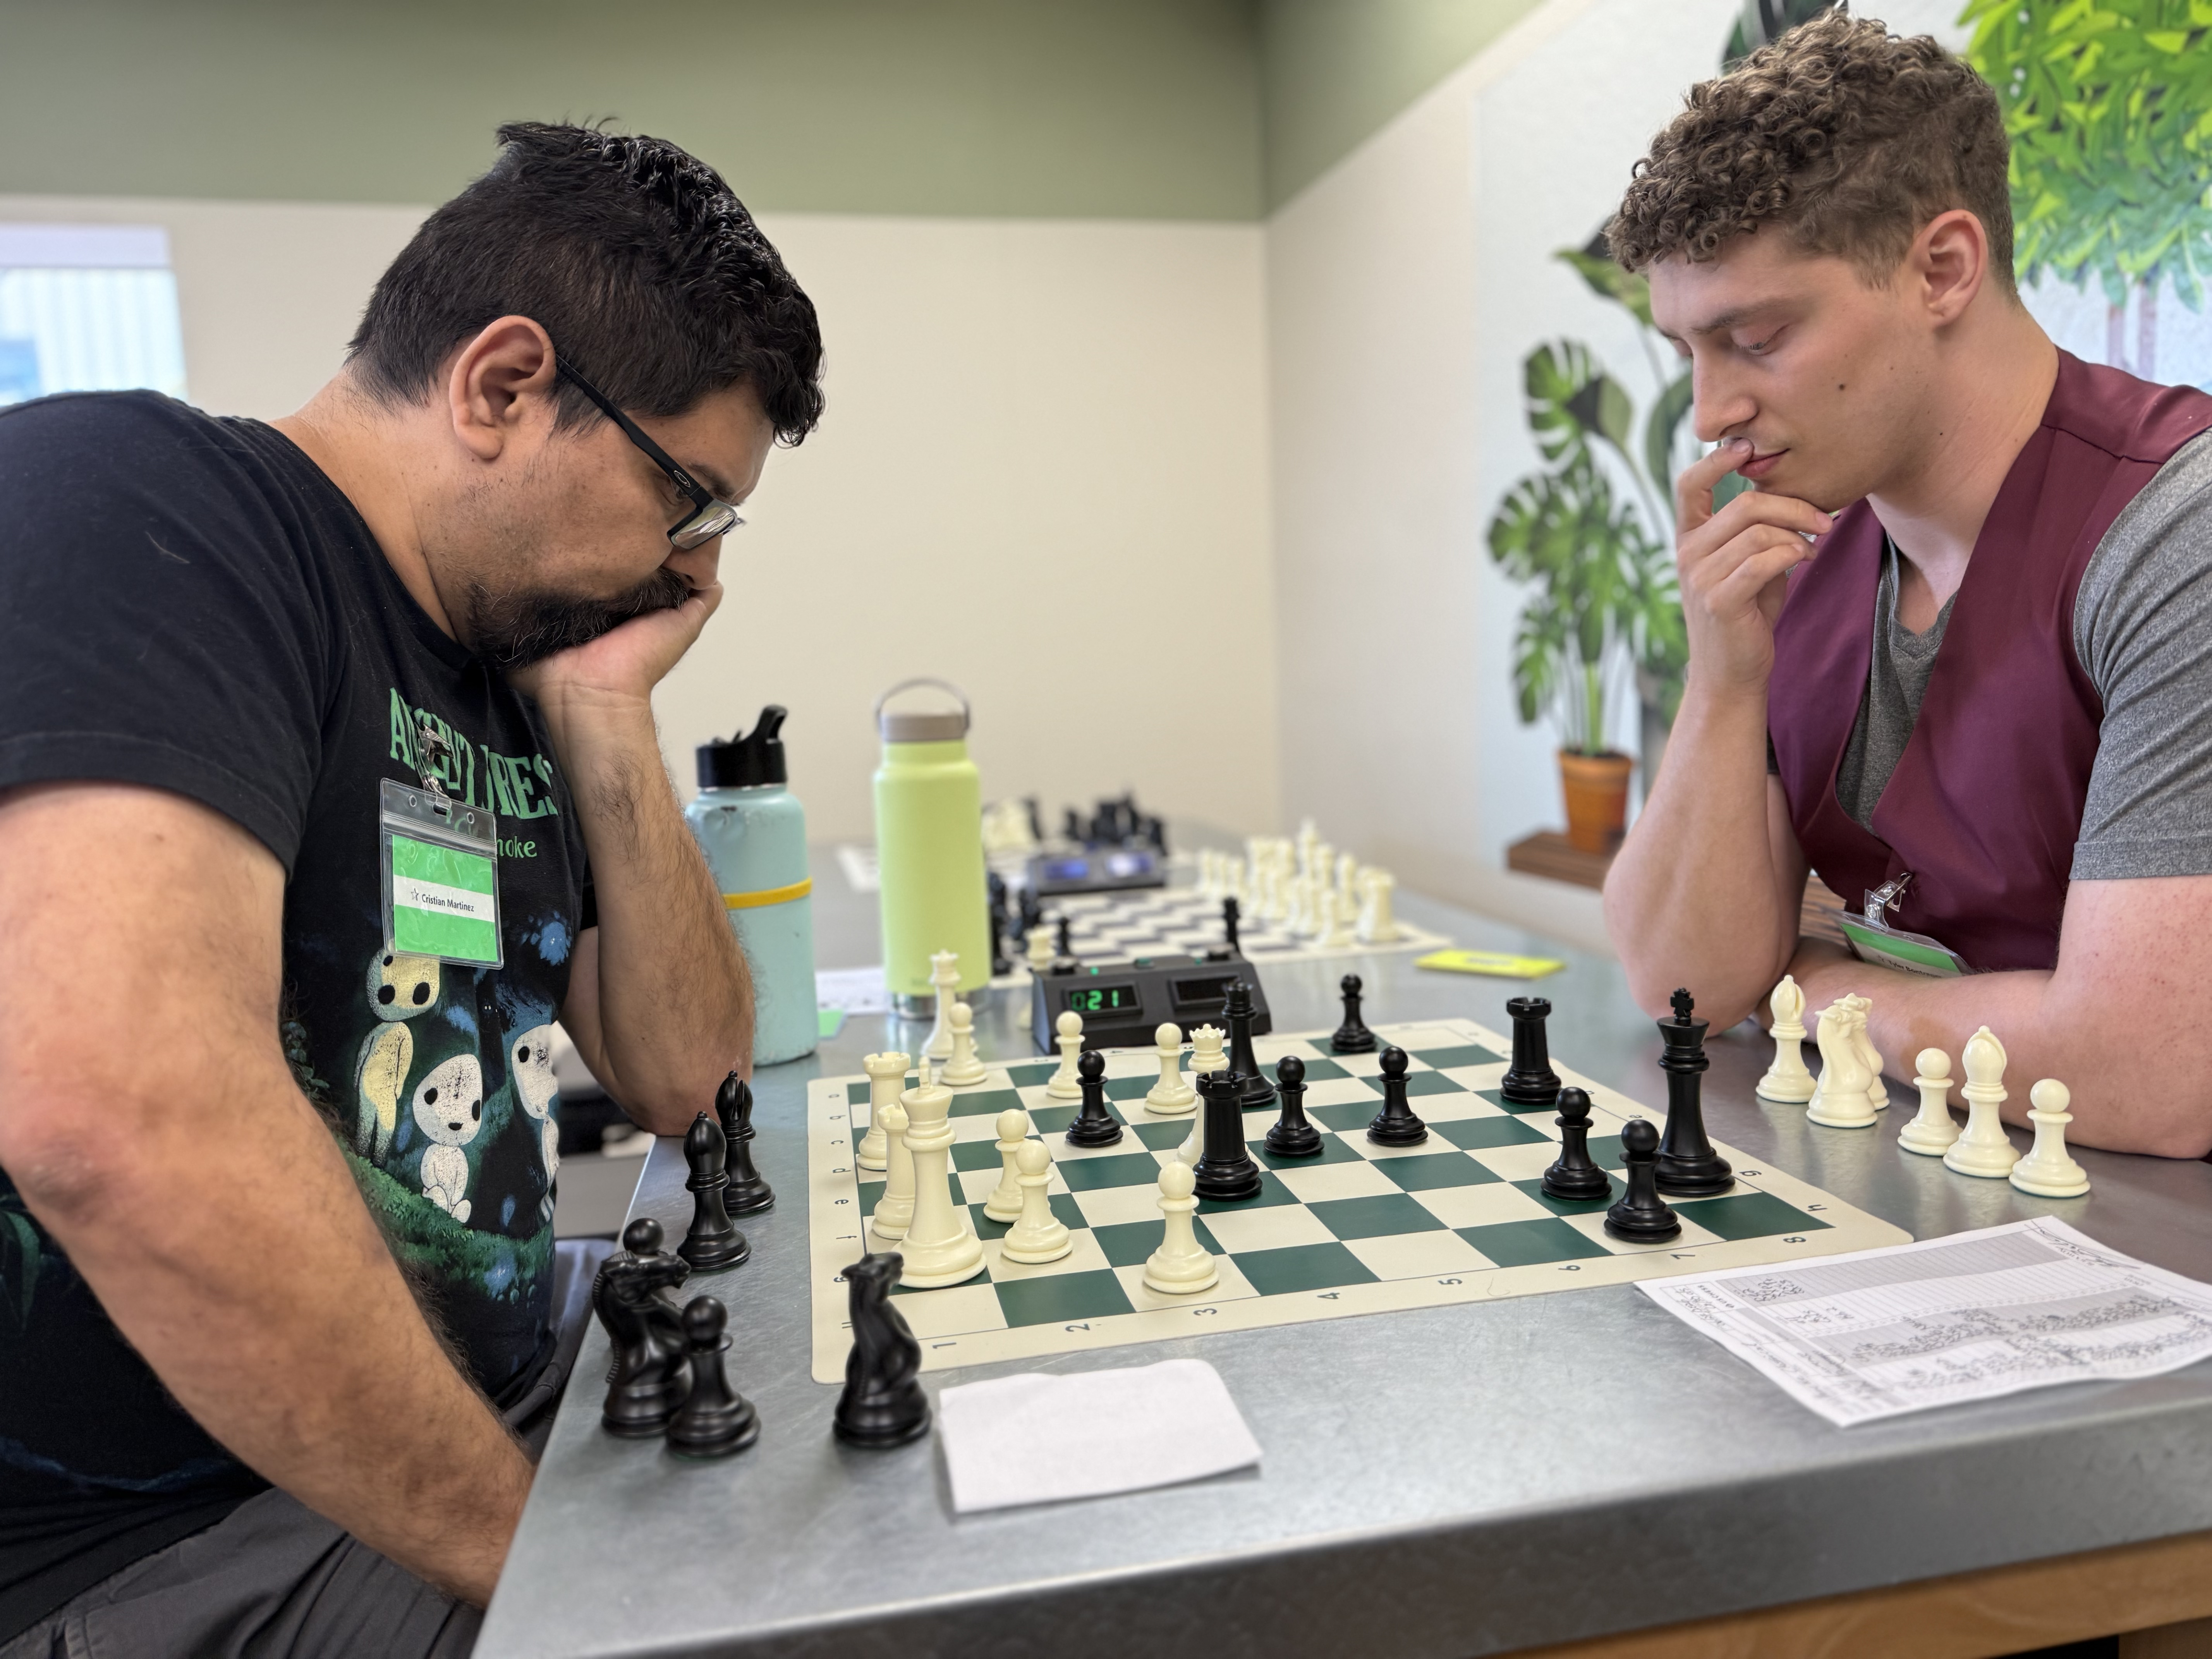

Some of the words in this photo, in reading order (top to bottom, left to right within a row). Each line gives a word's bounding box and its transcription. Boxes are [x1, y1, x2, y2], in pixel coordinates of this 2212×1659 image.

[497, 836, 538, 858] noke
[422, 894, 445, 907] Cristian
[447, 899, 474, 912] Martinez
[1065, 1323, 1090, 1333] 2
[1193, 1307, 1218, 1316] 3
[1317, 1292, 1340, 1300] 4
